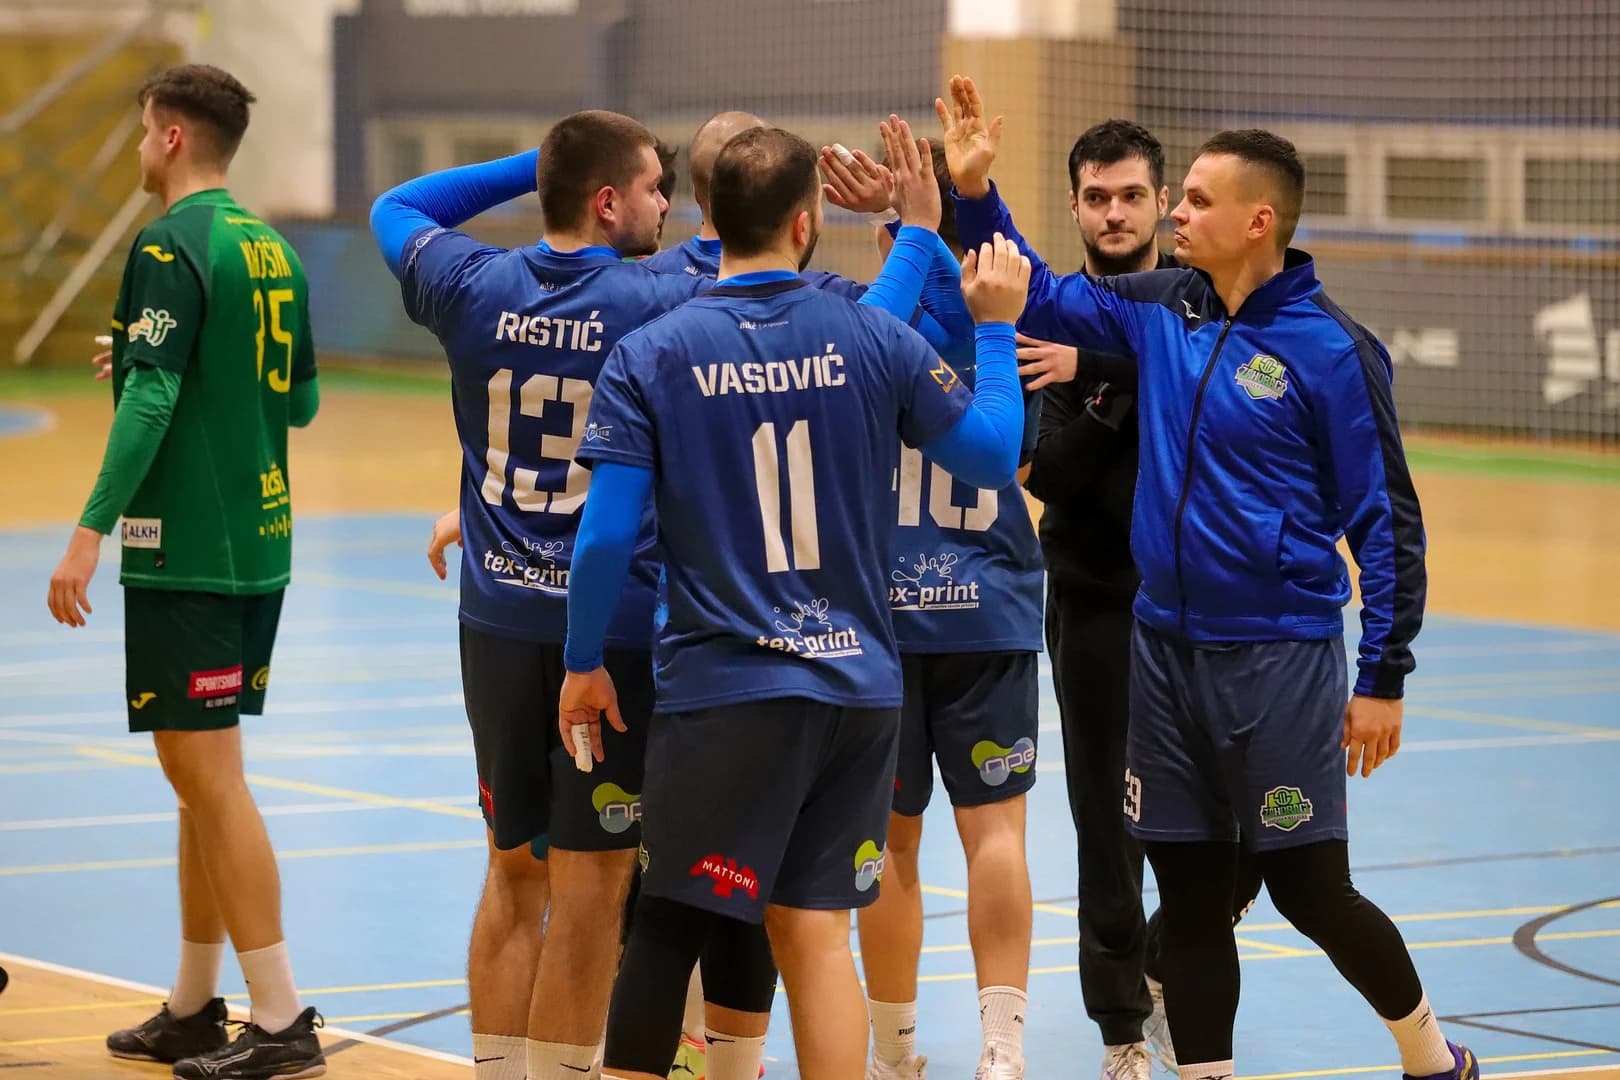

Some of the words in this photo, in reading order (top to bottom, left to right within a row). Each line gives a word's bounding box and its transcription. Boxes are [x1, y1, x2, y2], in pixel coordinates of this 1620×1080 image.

[495, 310, 604, 352] RISTIĆ
[691, 343, 846, 397] VASOVIĆ
[481, 367, 595, 515] 13
[752, 419, 821, 573] 11
[484, 549, 570, 586] tex-prin
[756, 626, 860, 656] tex-print
[702, 860, 755, 889] MATTONI
